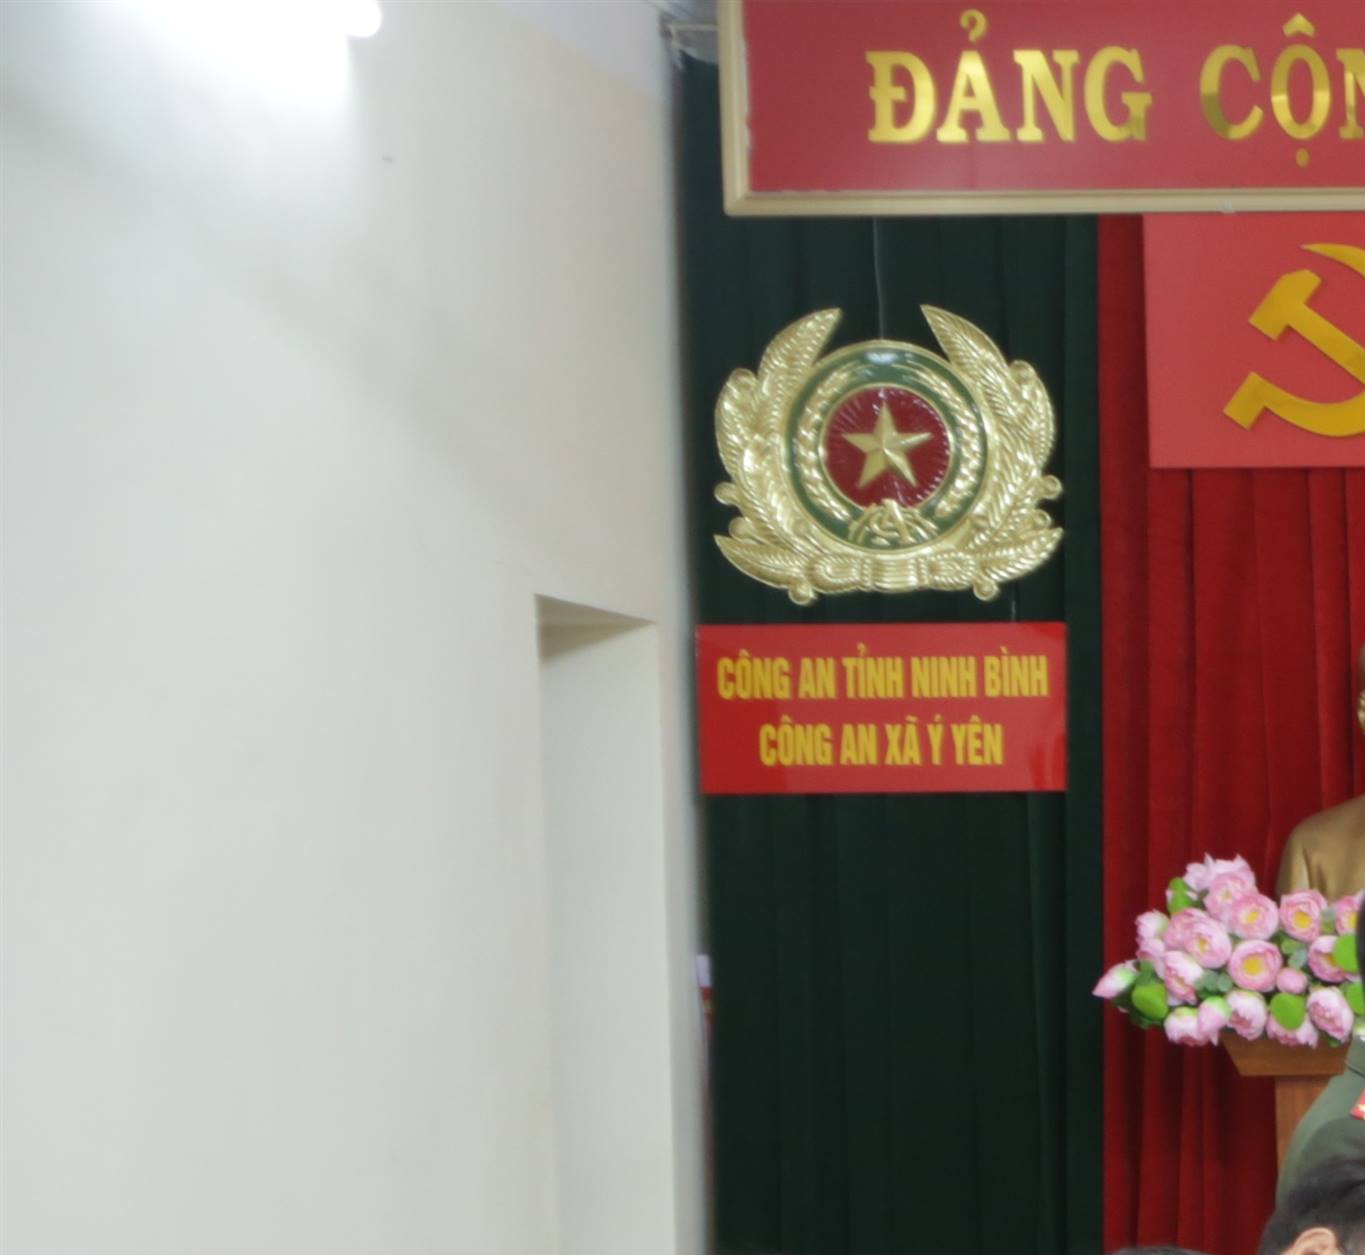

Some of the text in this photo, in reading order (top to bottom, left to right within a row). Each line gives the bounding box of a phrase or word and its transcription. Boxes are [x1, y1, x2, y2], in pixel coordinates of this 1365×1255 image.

[864, 8, 1153, 144] ĐẢNG
[717, 642, 1050, 700] CÔNG AN TỈNH NINH BÌNH
[759, 714, 1005, 767] CÔNG AN XÃ Ý YÊN
